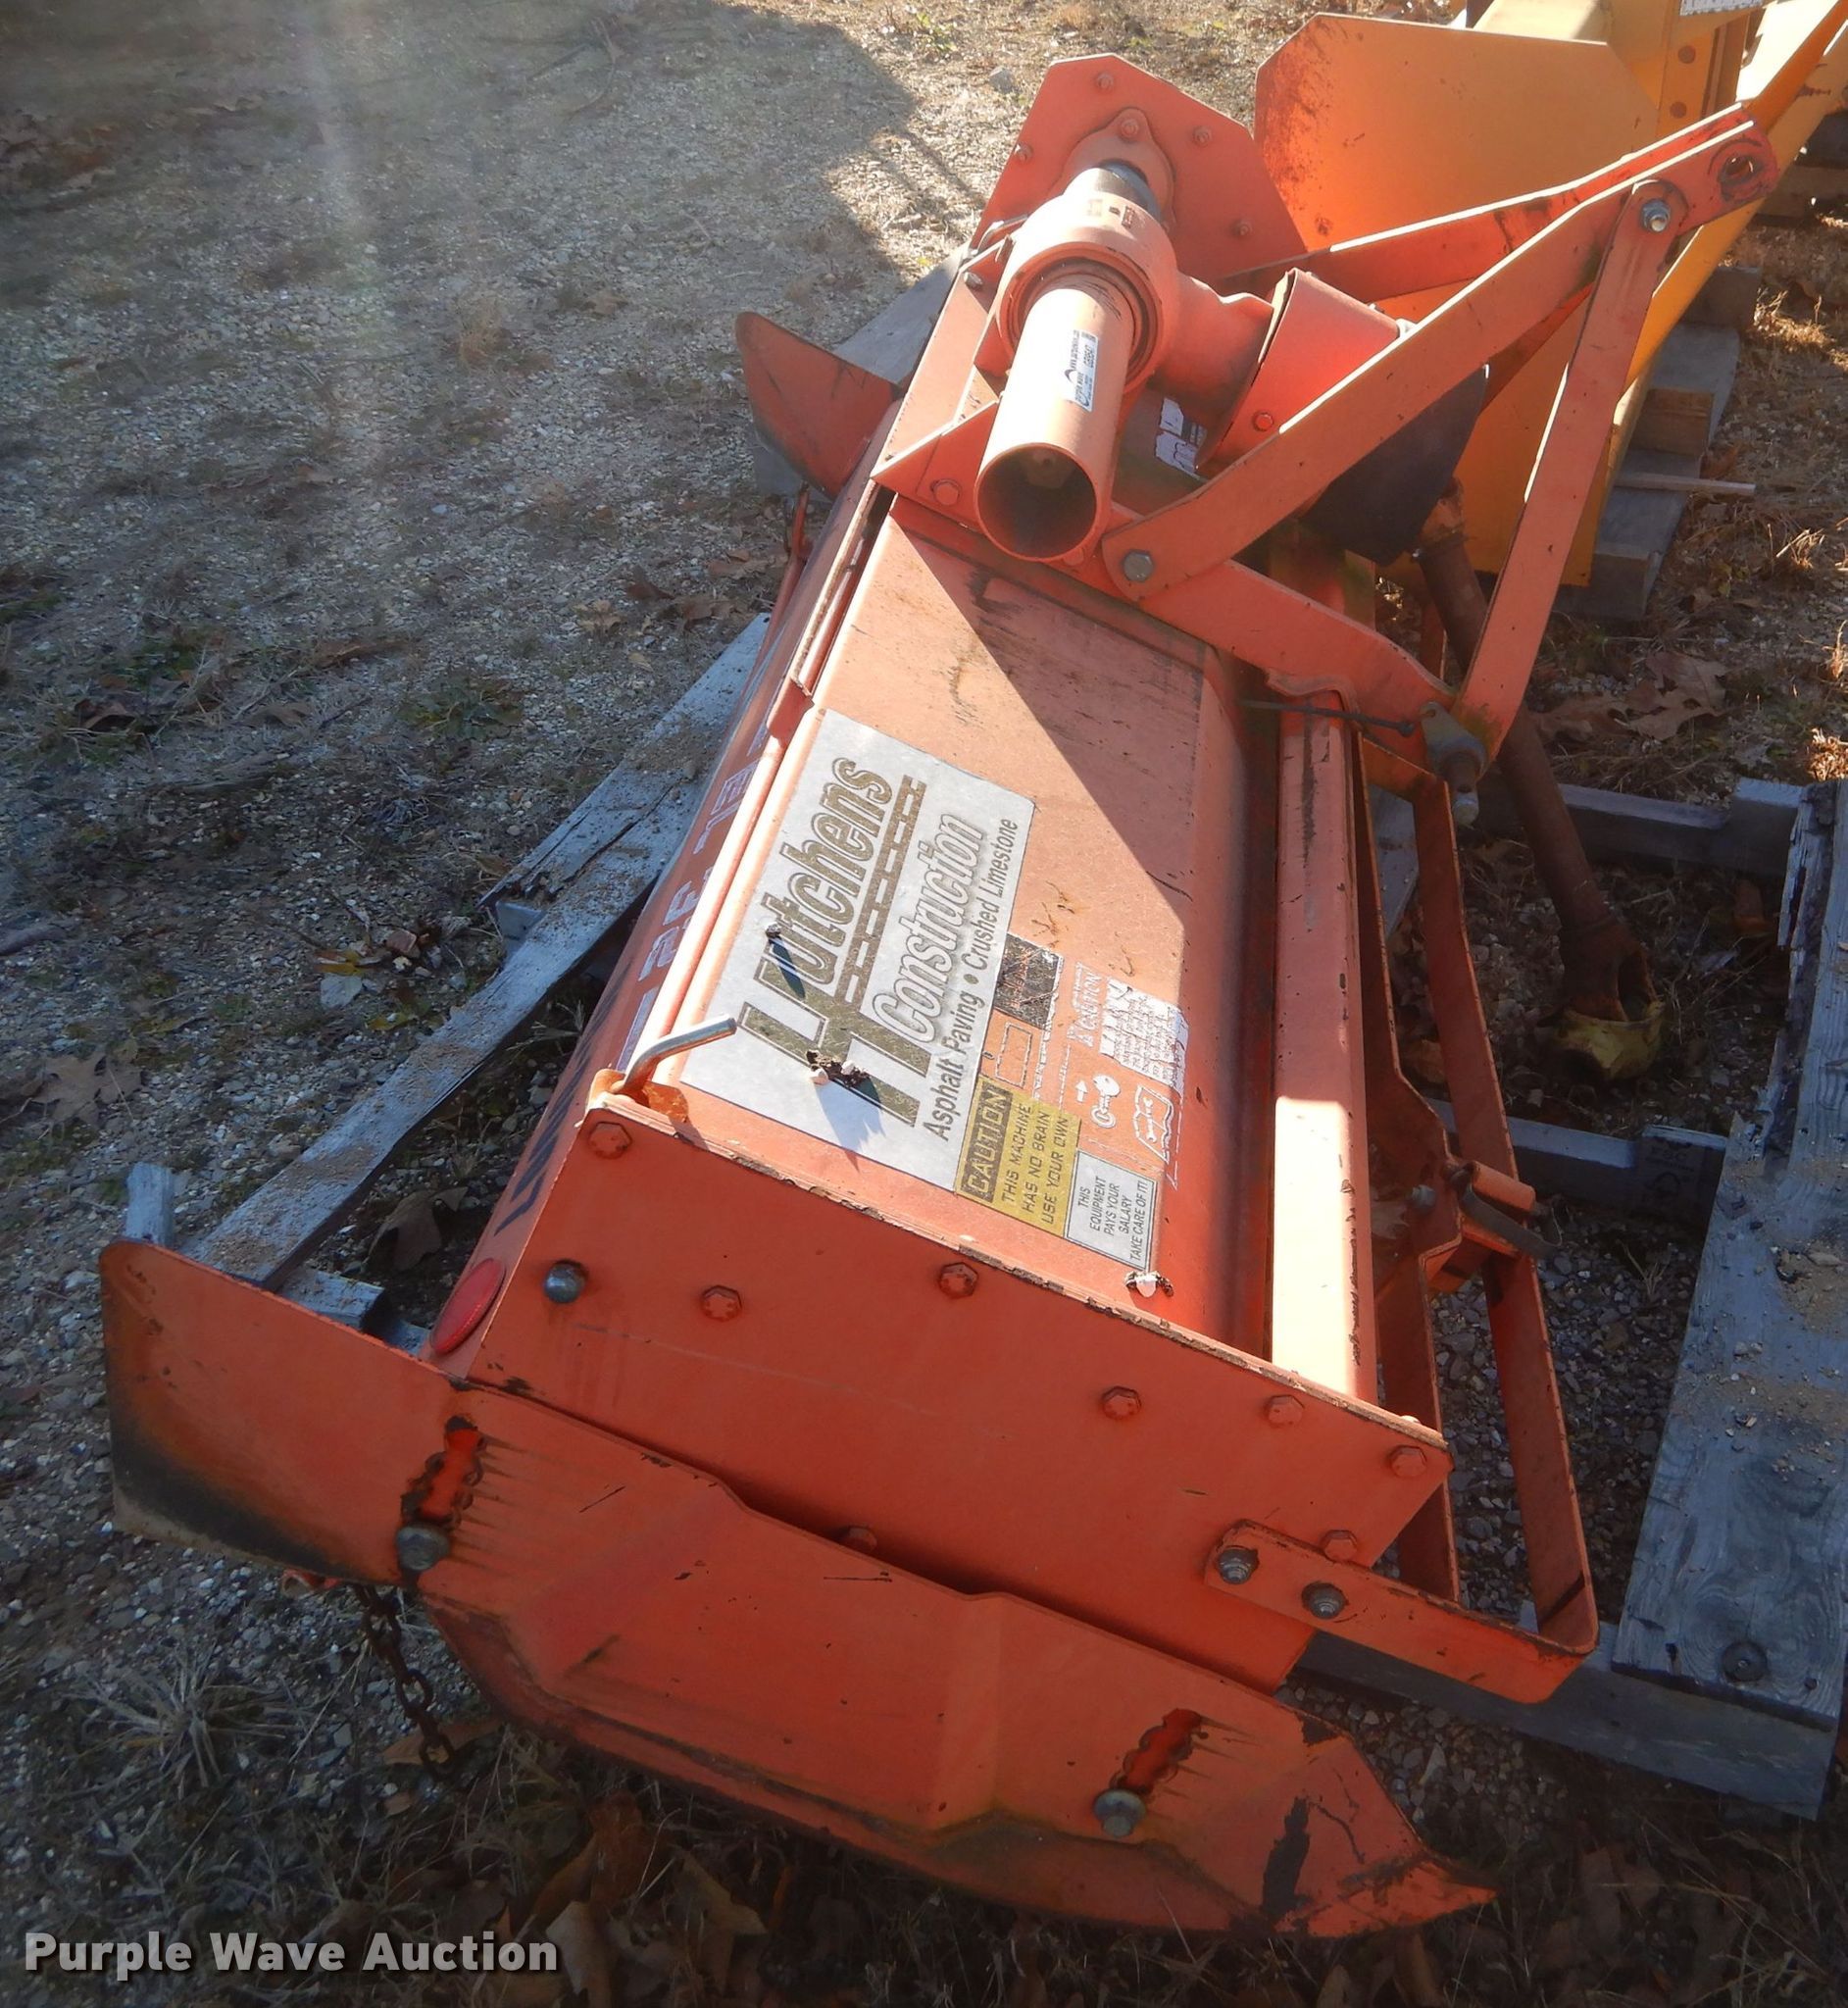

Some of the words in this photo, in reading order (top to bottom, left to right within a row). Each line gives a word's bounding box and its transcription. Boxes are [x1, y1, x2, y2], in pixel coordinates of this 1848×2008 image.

[978, 818, 1020, 898] Limestone
[737, 757, 930, 1128] Hutchens
[872, 813, 983, 1043] Construction
[962, 895, 1001, 971] Crushed
[940, 990, 985, 1055] Paving
[923, 1057, 965, 1142] Asphalt
[967, 1087, 1009, 1194] CAUTION
[1009, 1102, 1031, 1166] MACHINE
[1031, 1110, 1051, 1152] BRAIN
[1054, 1116, 1069, 1147] OWN
[1028, 1153, 1043, 1177] NO
[1047, 1151, 1064, 1188] YOUR
[1001, 1169, 1020, 1203] THIS
[1022, 1180, 1039, 1215] HAS
[1078, 1186, 1091, 1209] THIS
[1089, 1176, 1107, 1231] EQUIPMENT
[1109, 1182, 1121, 1211] YOUR
[1136, 1193, 1146, 1208] OF
[1137, 1180, 1148, 1194] IT!
[1041, 1193, 1057, 1224] USE
[1103, 1211, 1118, 1236] PAYS
[1118, 1195, 1132, 1233] SALARY
[1132, 1208, 1146, 1234] CARE
[1129, 1235, 1143, 1261] TAKE
